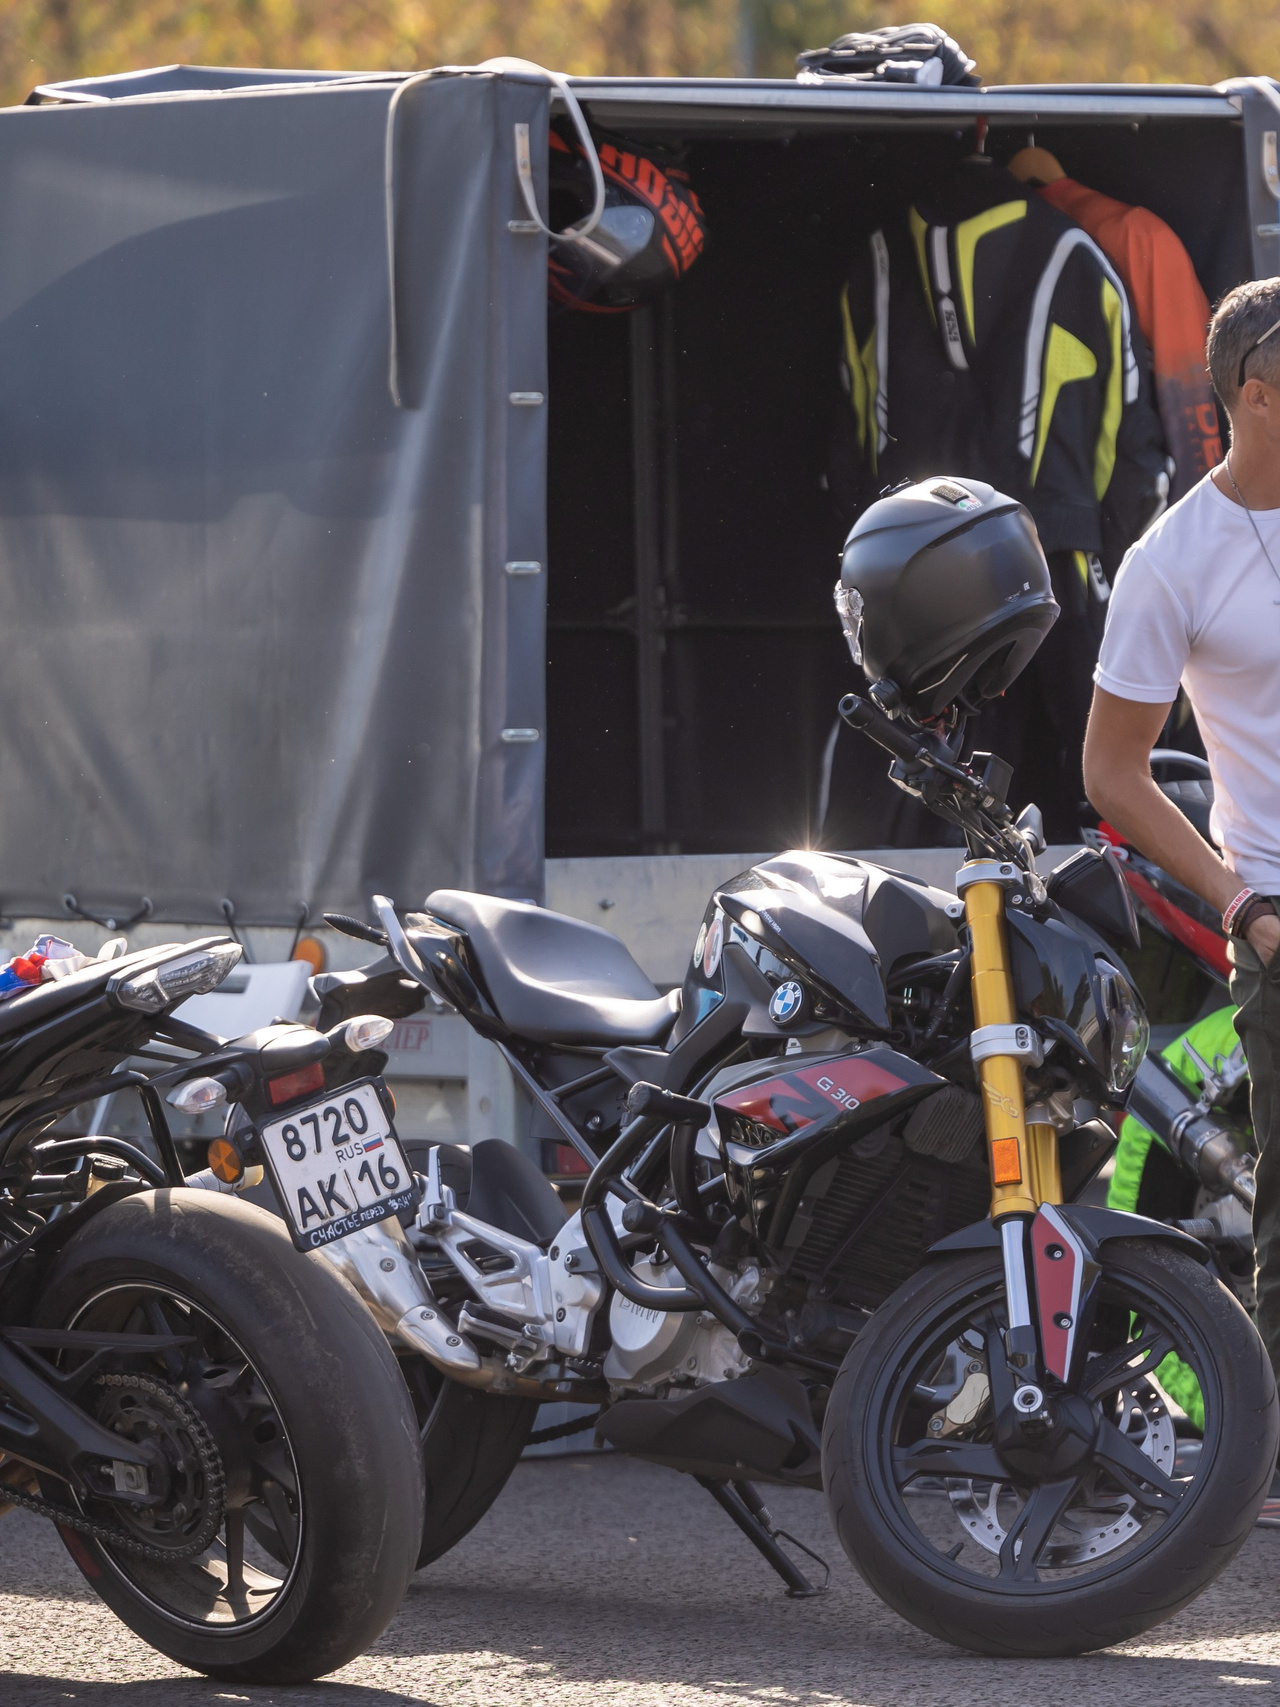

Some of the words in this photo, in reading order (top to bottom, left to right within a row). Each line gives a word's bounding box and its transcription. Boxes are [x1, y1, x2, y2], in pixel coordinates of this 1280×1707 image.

[776, 981, 801, 998] BMW
[816, 1076, 834, 1092] G
[830, 1087, 860, 1110] 310
[281, 1097, 369, 1162] 8720
[335, 1142, 364, 1164] RUS
[357, 1152, 400, 1197] 16
[310, 1213, 361, 1247] СЧАСТЬЕ
